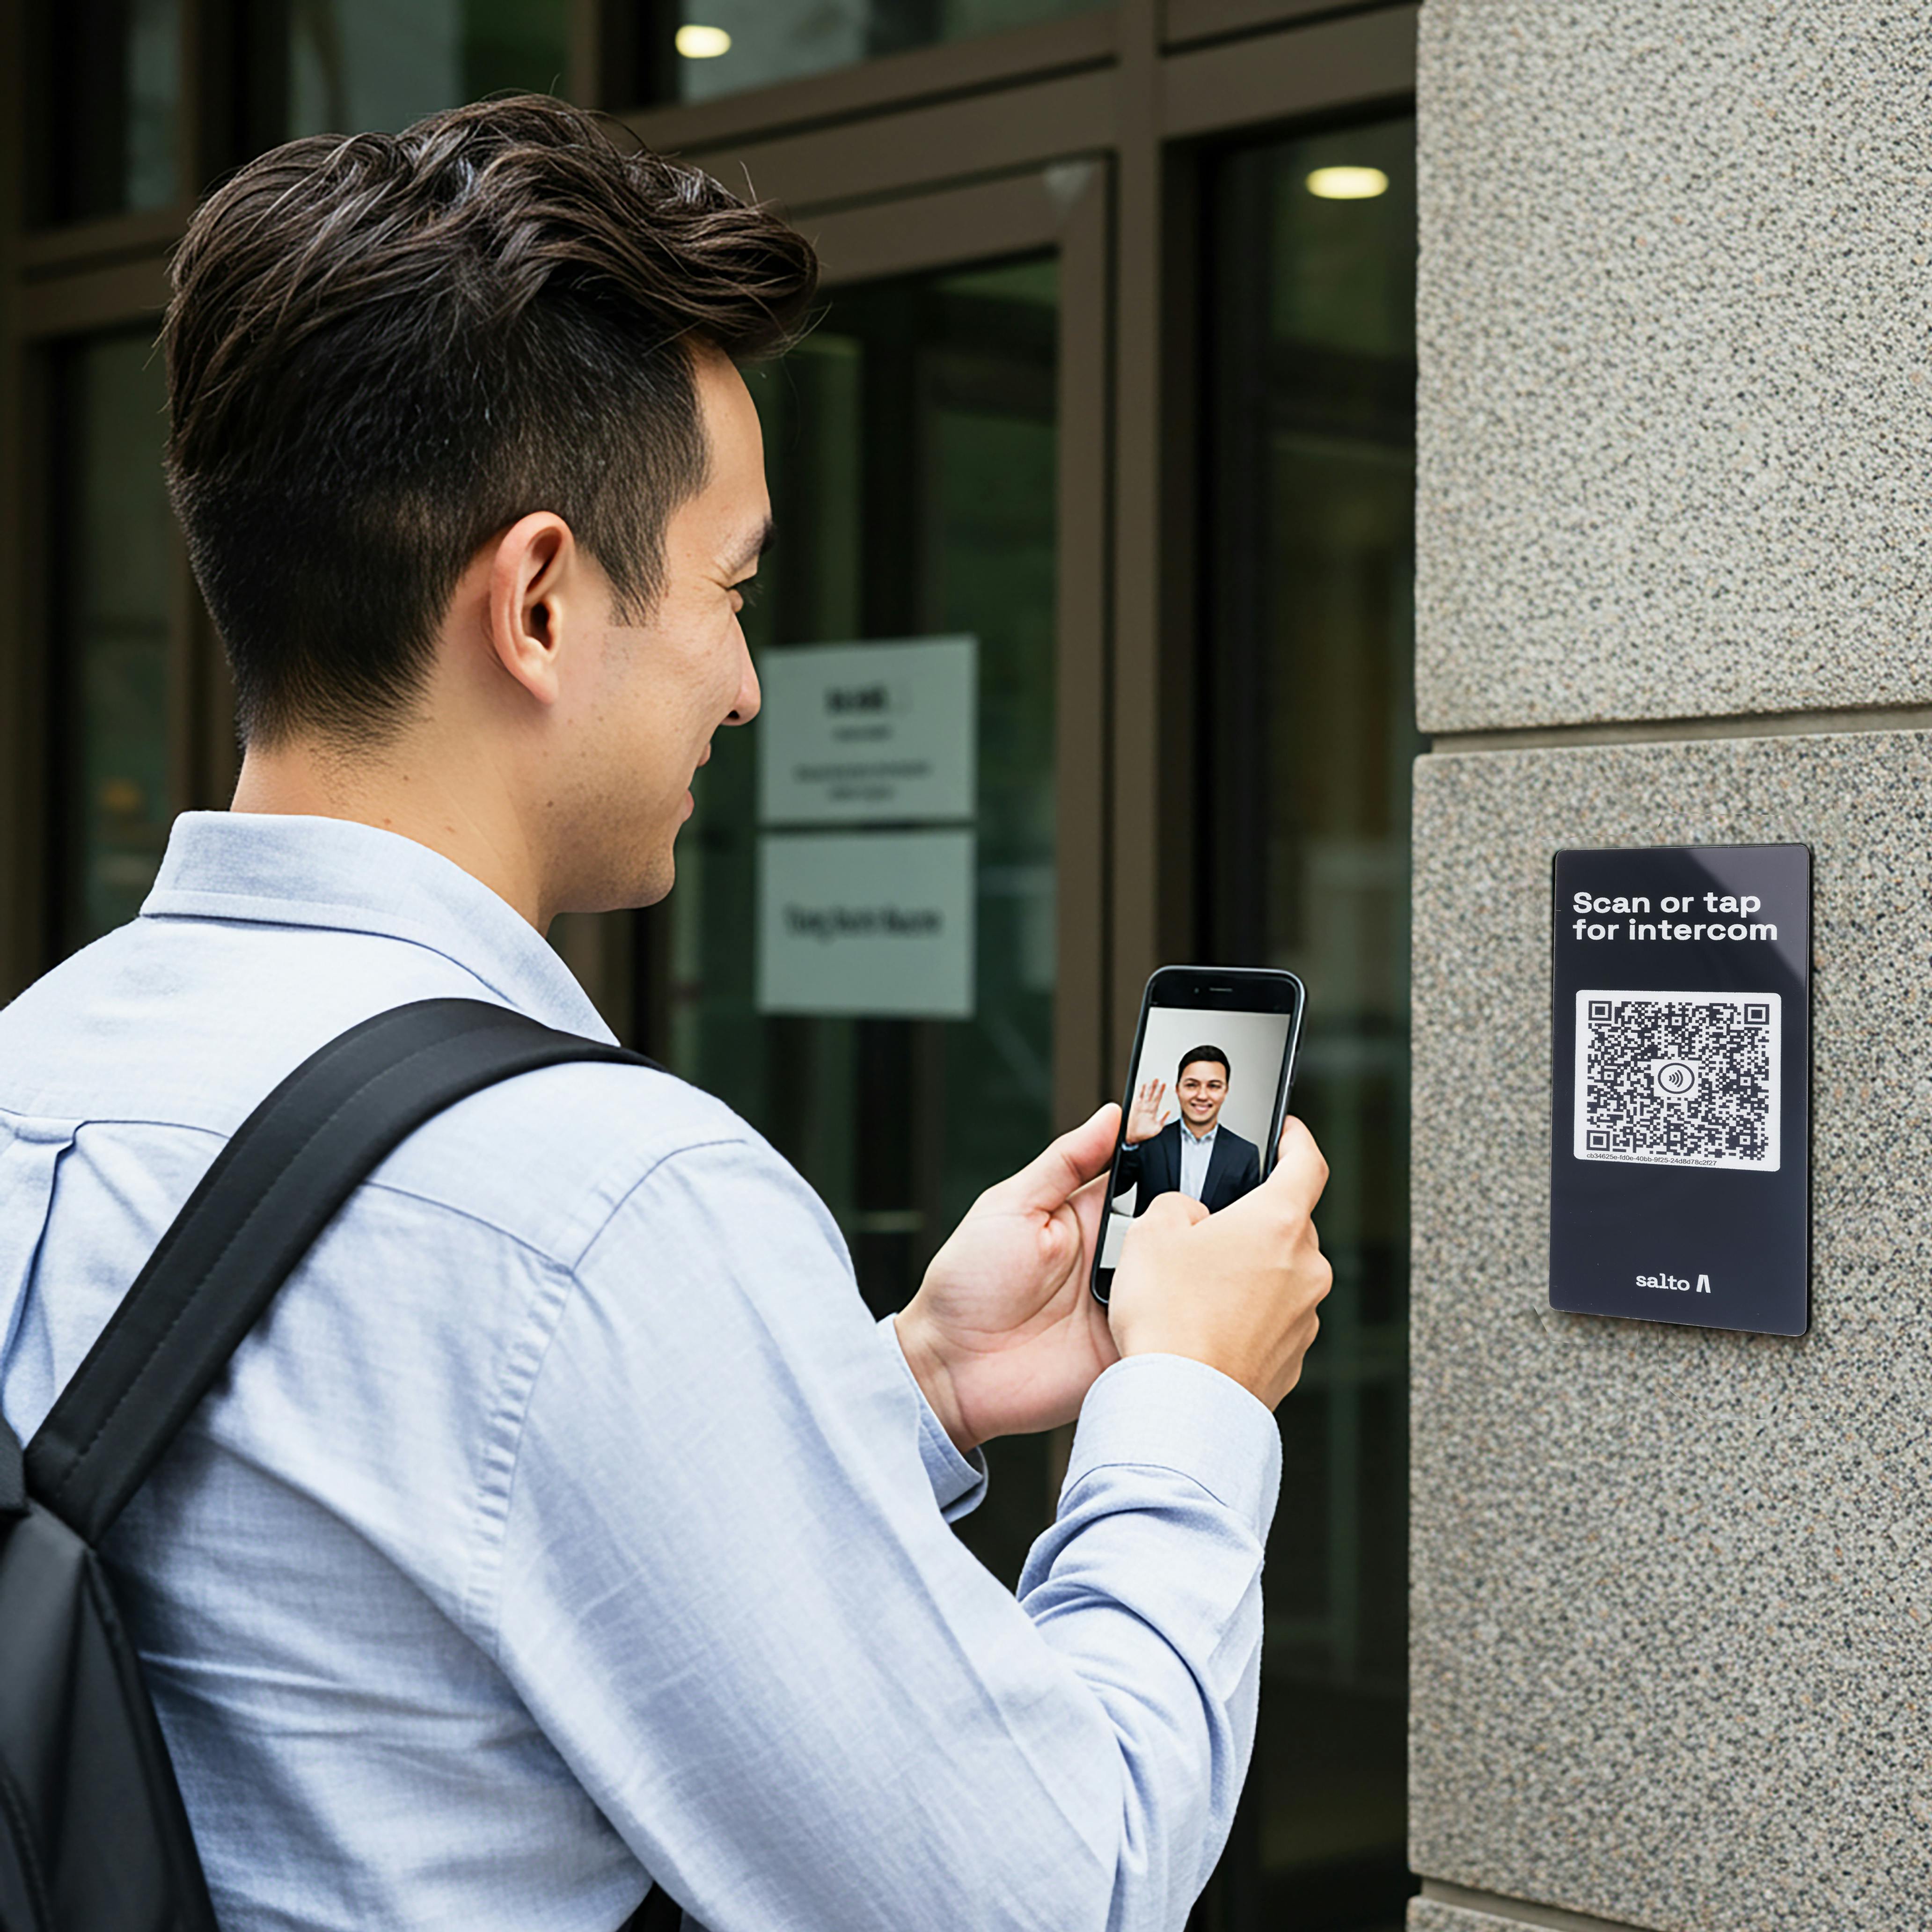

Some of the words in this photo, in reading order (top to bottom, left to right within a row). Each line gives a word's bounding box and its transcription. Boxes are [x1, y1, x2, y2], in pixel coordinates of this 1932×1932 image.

[1573, 892, 1650, 914] Scan
[1661, 896, 1694, 913] or
[1703, 892, 1761, 918] tap
[1573, 919, 1619, 940] for
[1629, 918, 1778, 941] intercom
[1587, 1153, 1717, 1166] cb34625e-fd0e-40bb-9f25-24d8d78c2f27
[1636, 1273, 1690, 1291] salto
